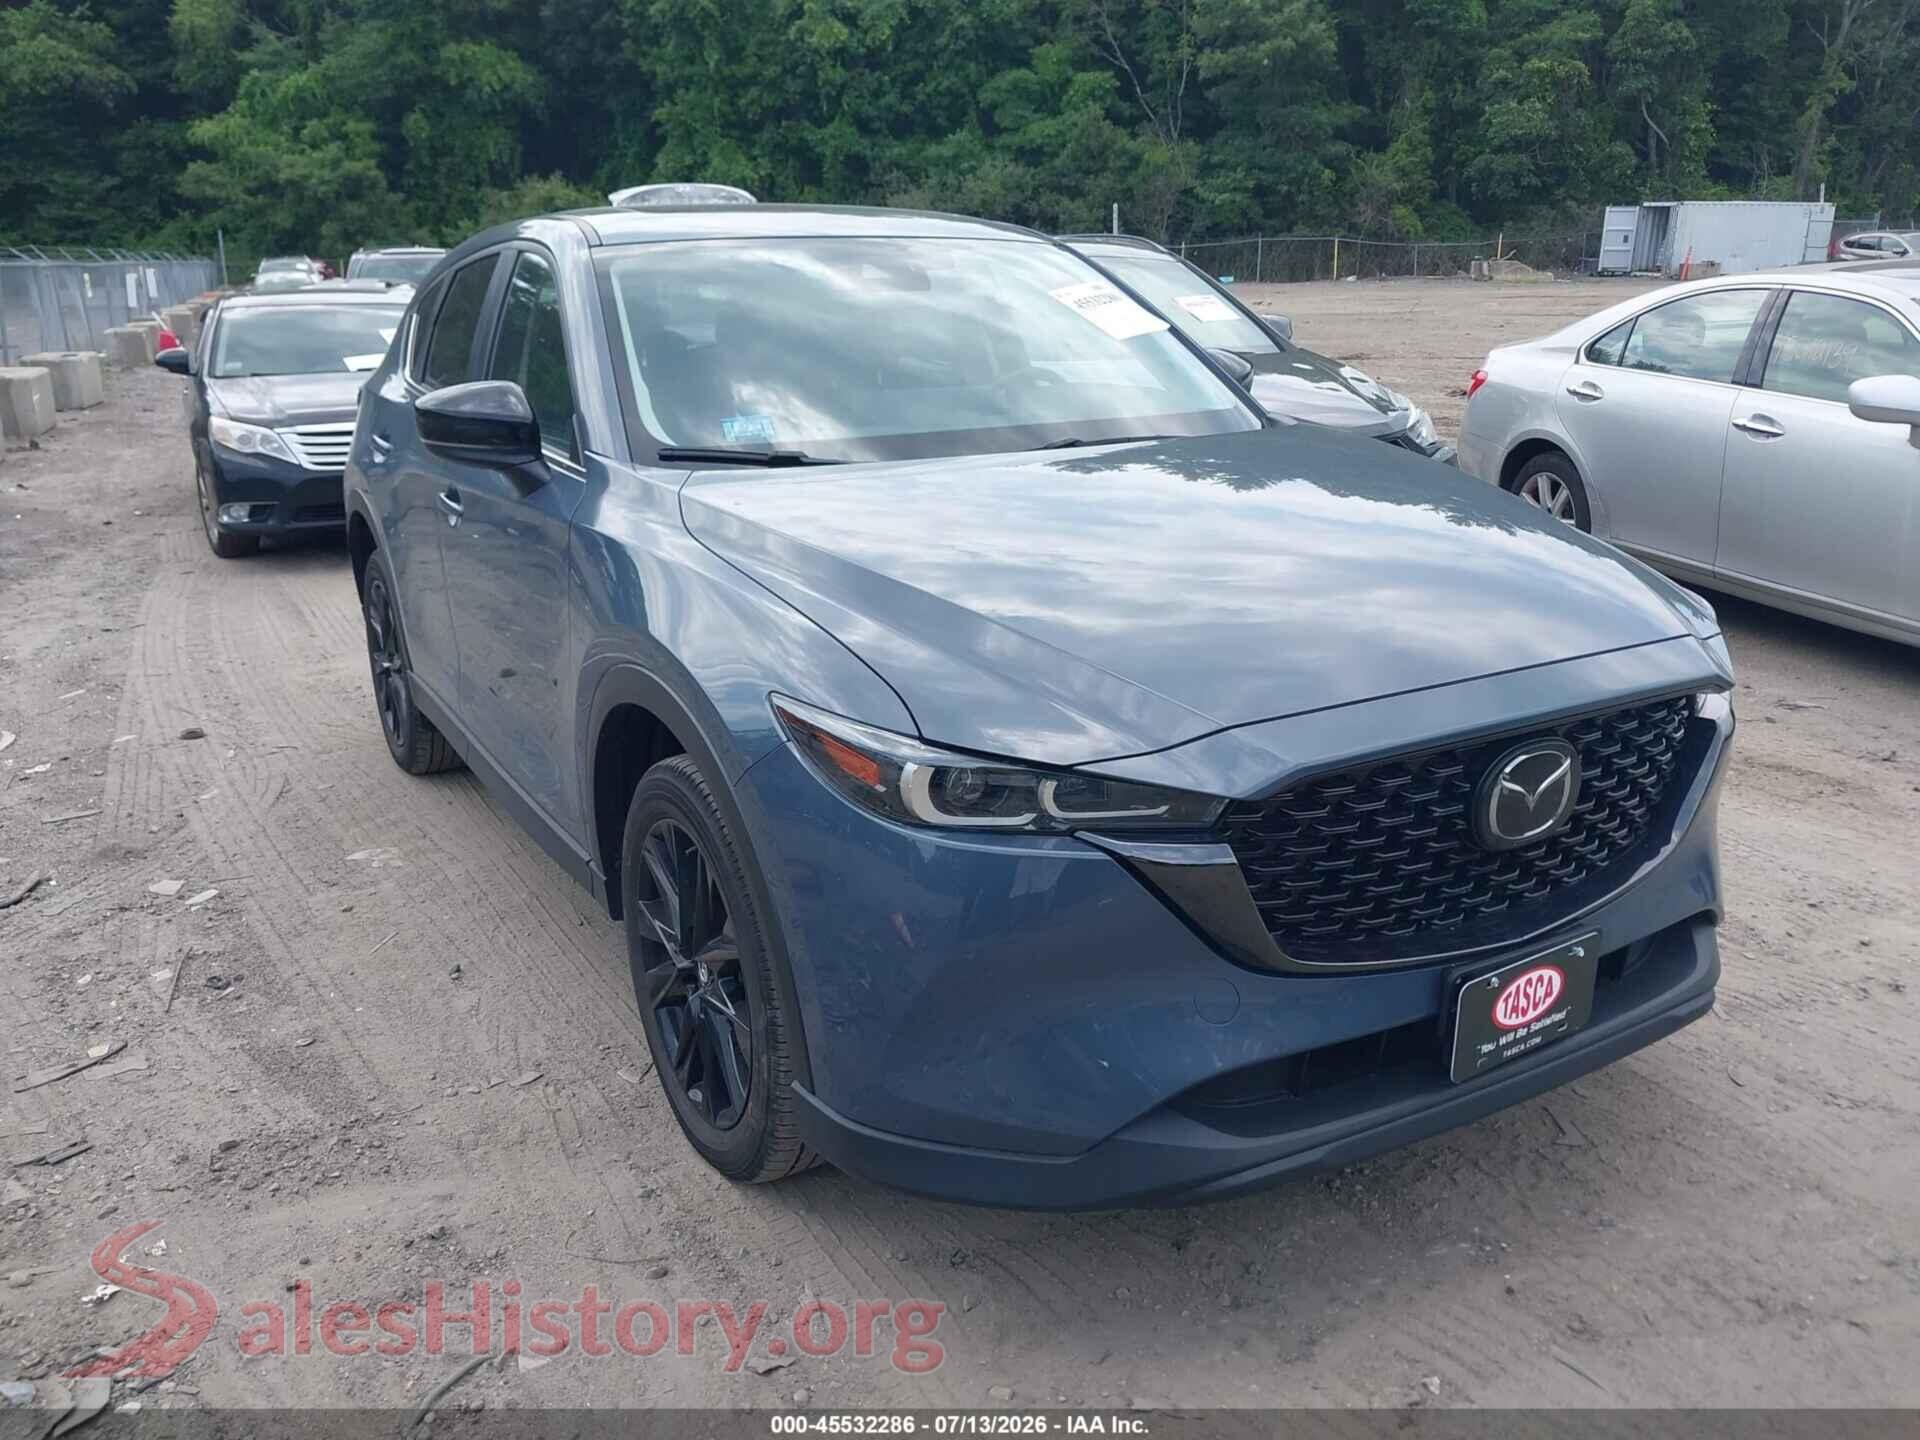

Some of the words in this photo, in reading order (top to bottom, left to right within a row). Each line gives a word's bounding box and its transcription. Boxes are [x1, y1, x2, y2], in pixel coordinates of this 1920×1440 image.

[1502, 974, 1554, 1019] TASCA
[1499, 1031, 1515, 1046] Will
[1516, 1027, 1527, 1040] Be
[1503, 1036, 1542, 1058] TASCA.COM
